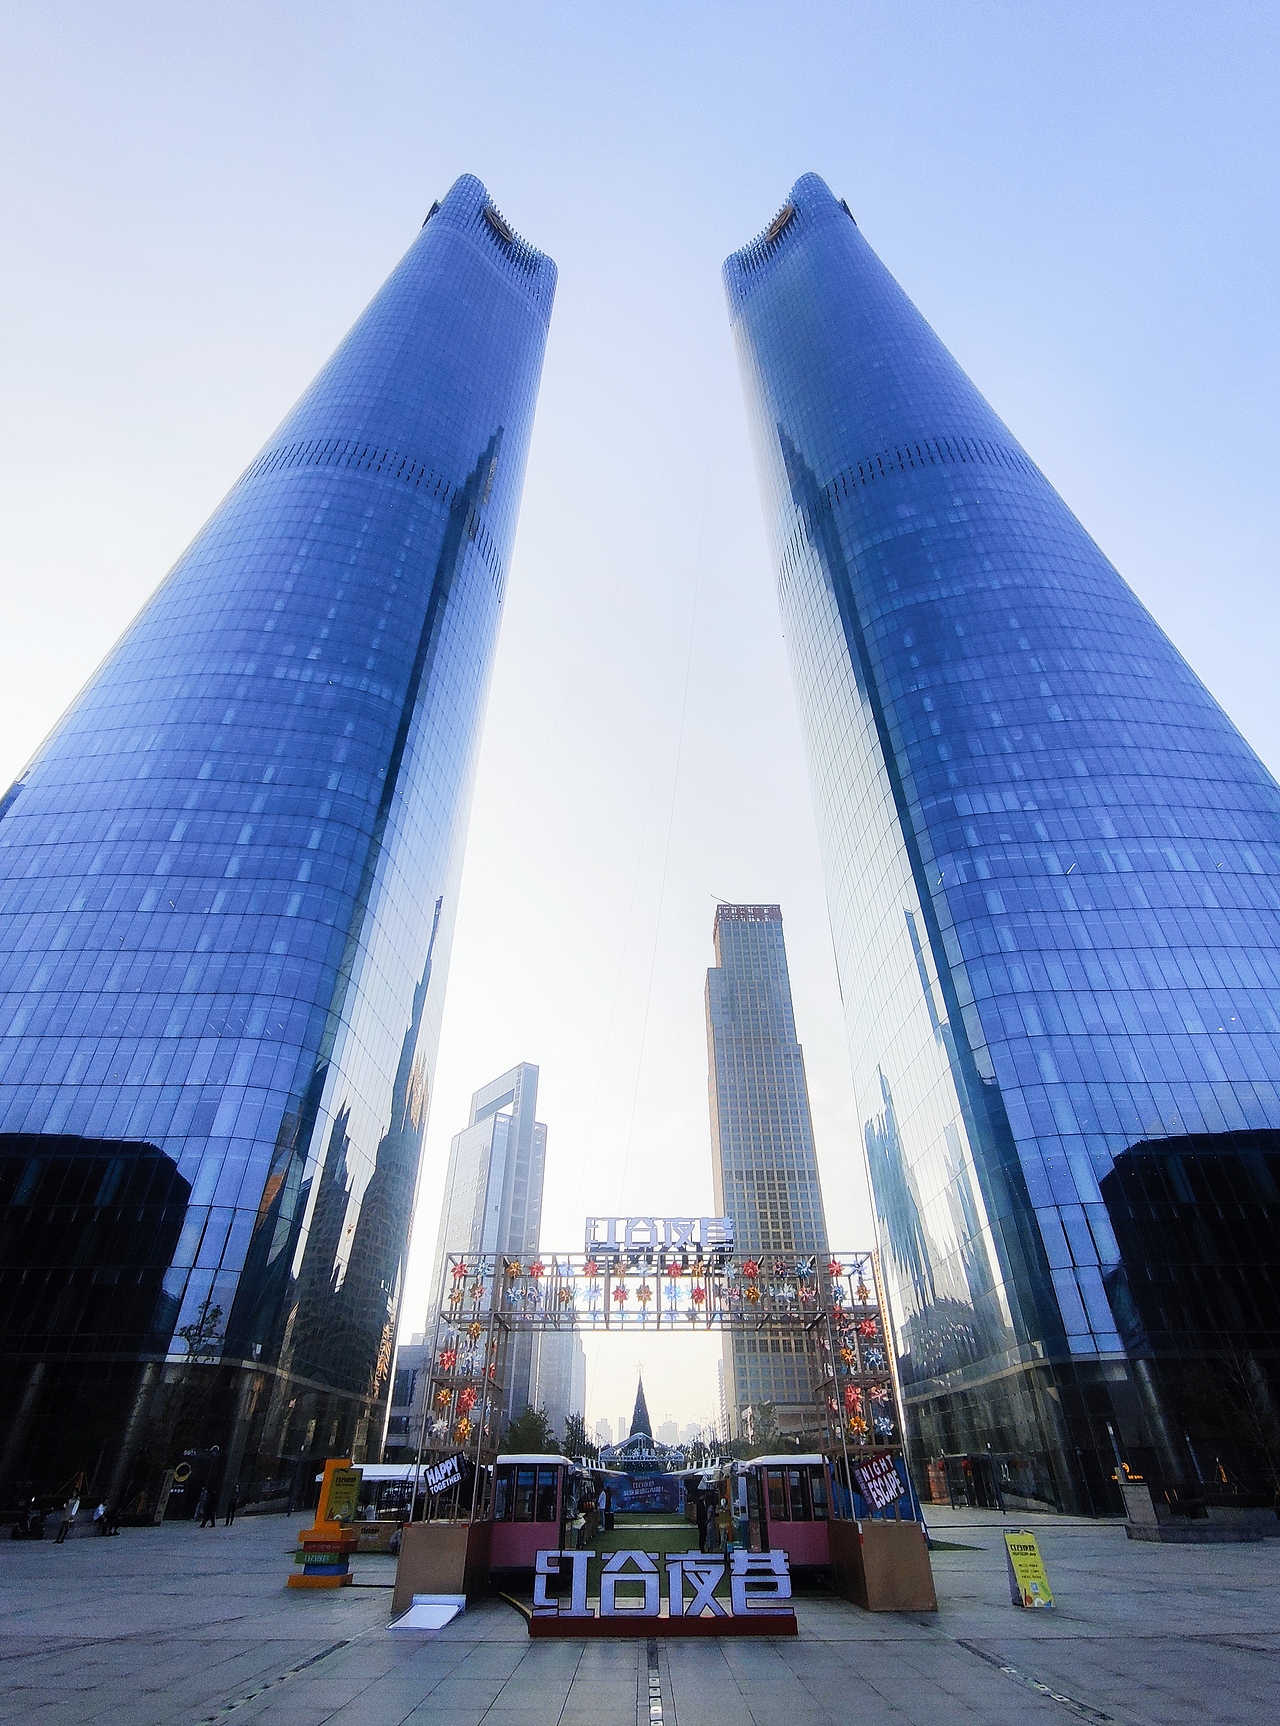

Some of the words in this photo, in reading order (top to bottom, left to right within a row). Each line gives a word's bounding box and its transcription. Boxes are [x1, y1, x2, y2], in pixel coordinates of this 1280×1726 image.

[585, 1217, 733, 1249] 红谷夜巷
[426, 1455, 458, 1486] HAPPY
[429, 1472, 462, 1494] TOGETHER
[860, 1455, 893, 1481] NIGHT
[867, 1469, 905, 1508] ESCAPE
[532, 1549, 794, 1618] 红谷夜巷
